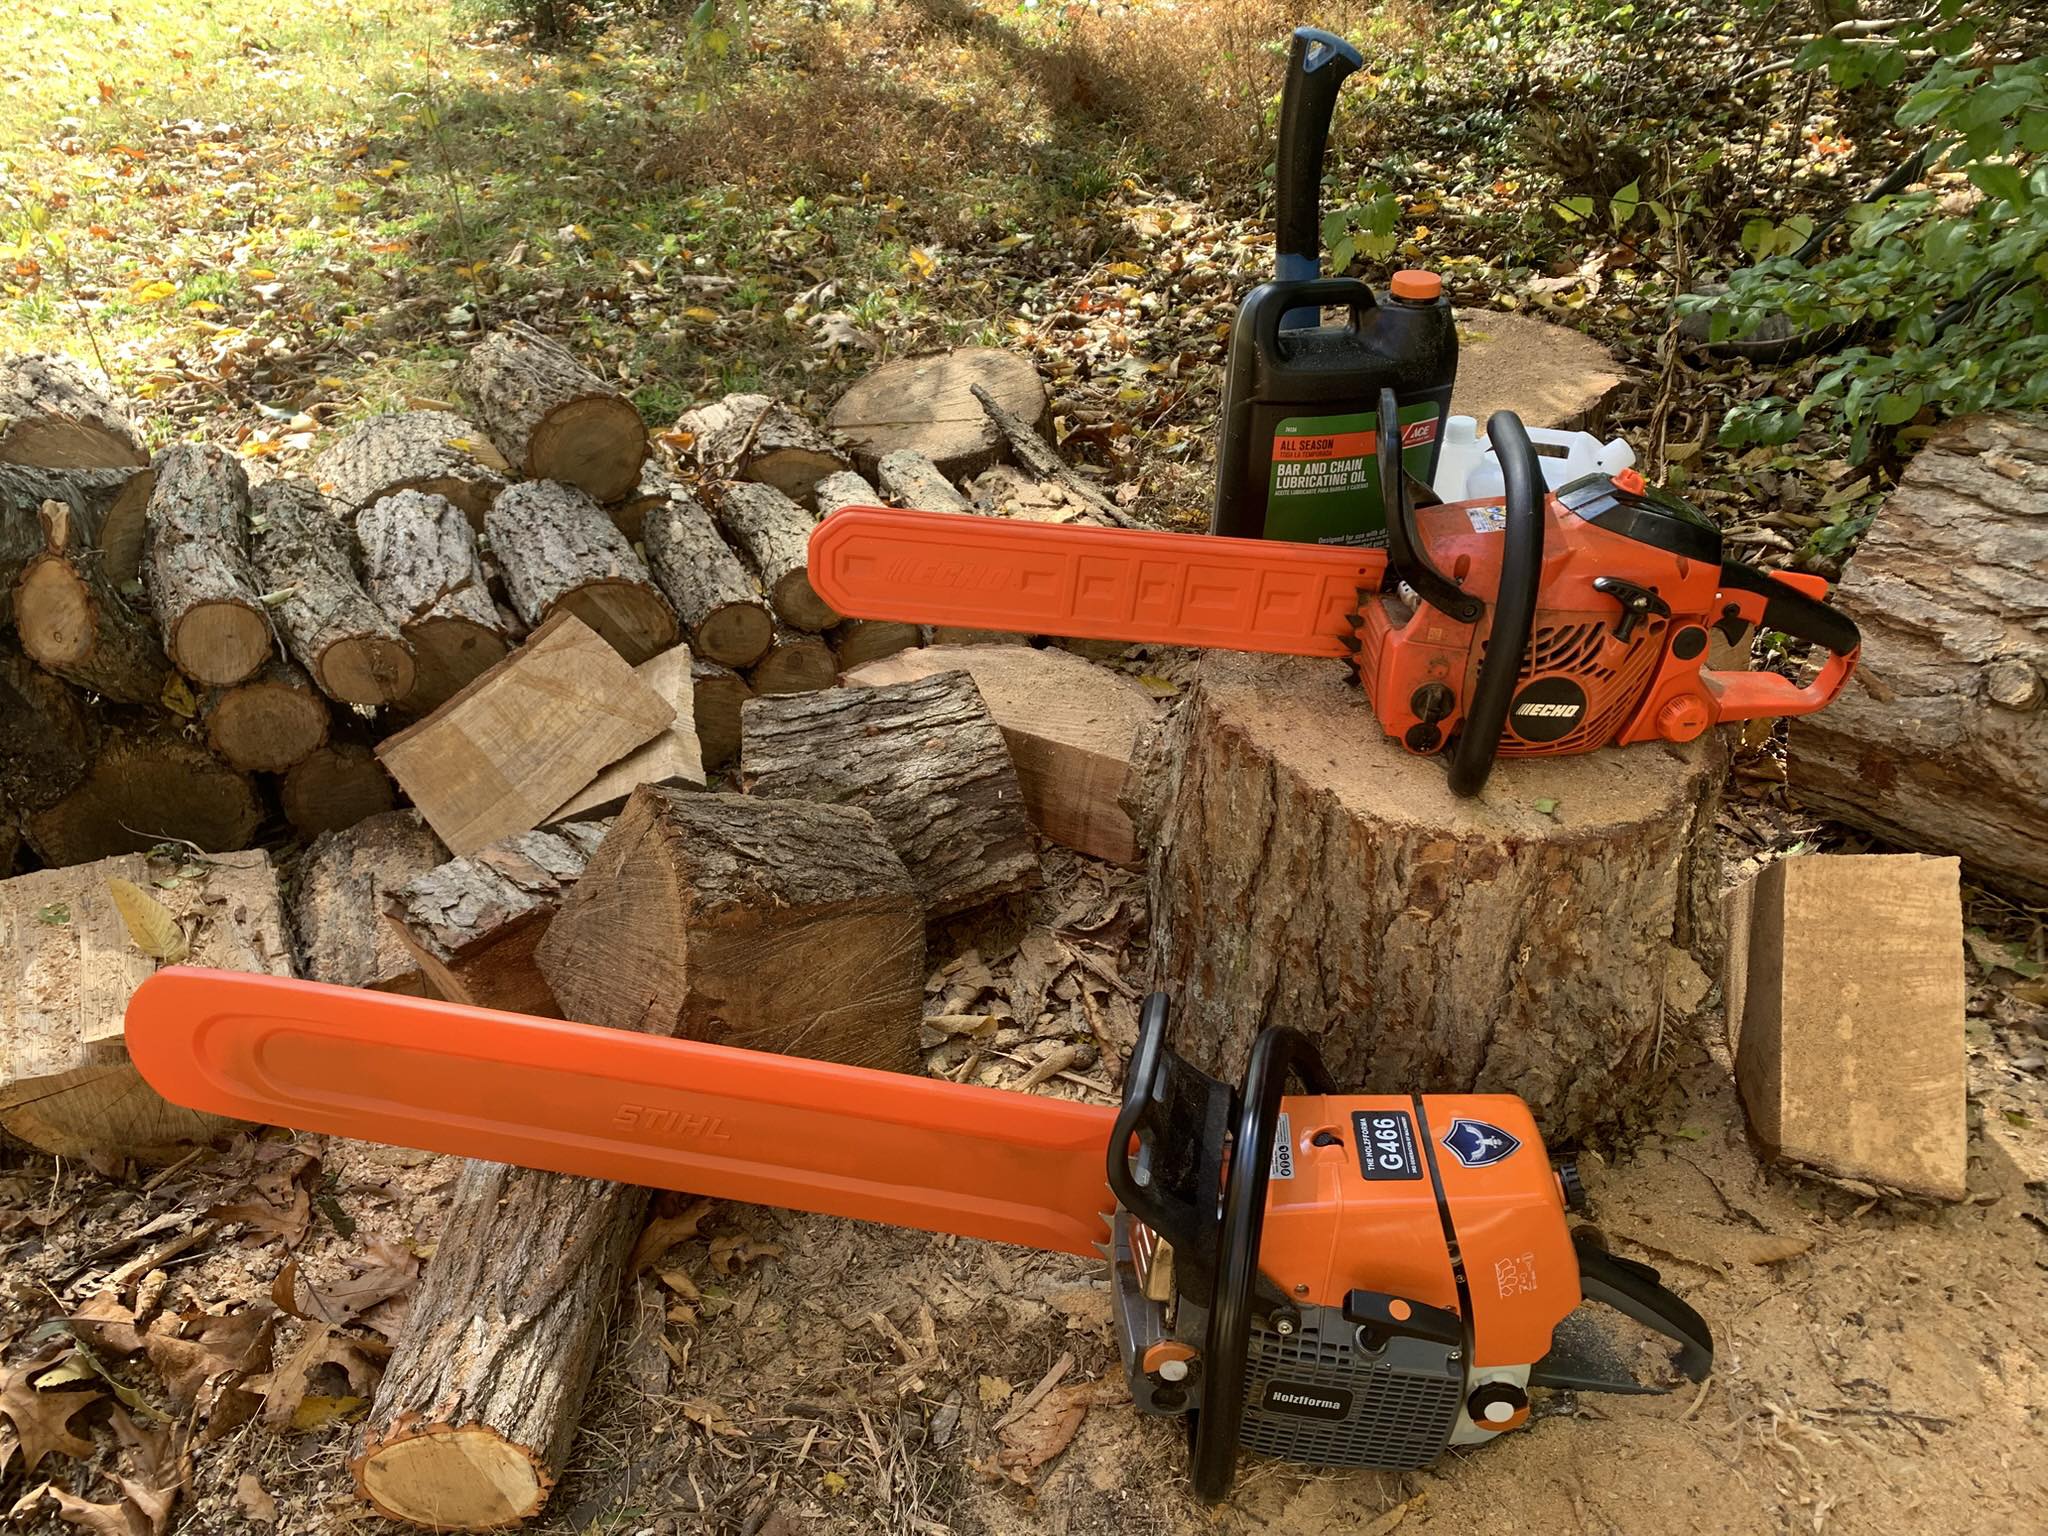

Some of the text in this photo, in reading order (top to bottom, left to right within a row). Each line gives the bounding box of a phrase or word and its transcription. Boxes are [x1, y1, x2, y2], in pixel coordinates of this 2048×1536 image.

[1410, 425, 1430, 438] ACE
[1280, 439, 1334, 451] ALL SEASON
[1277, 458, 1363, 476] BAR AND CHAIN
[1276, 470, 1367, 489] LUBRICATING OIL
[1527, 703, 1580, 718] ECHO
[612, 1103, 732, 1140] STIHL
[1359, 1118, 1375, 1171] THE HOLZFFORMA
[1373, 1118, 1404, 1170] G466
